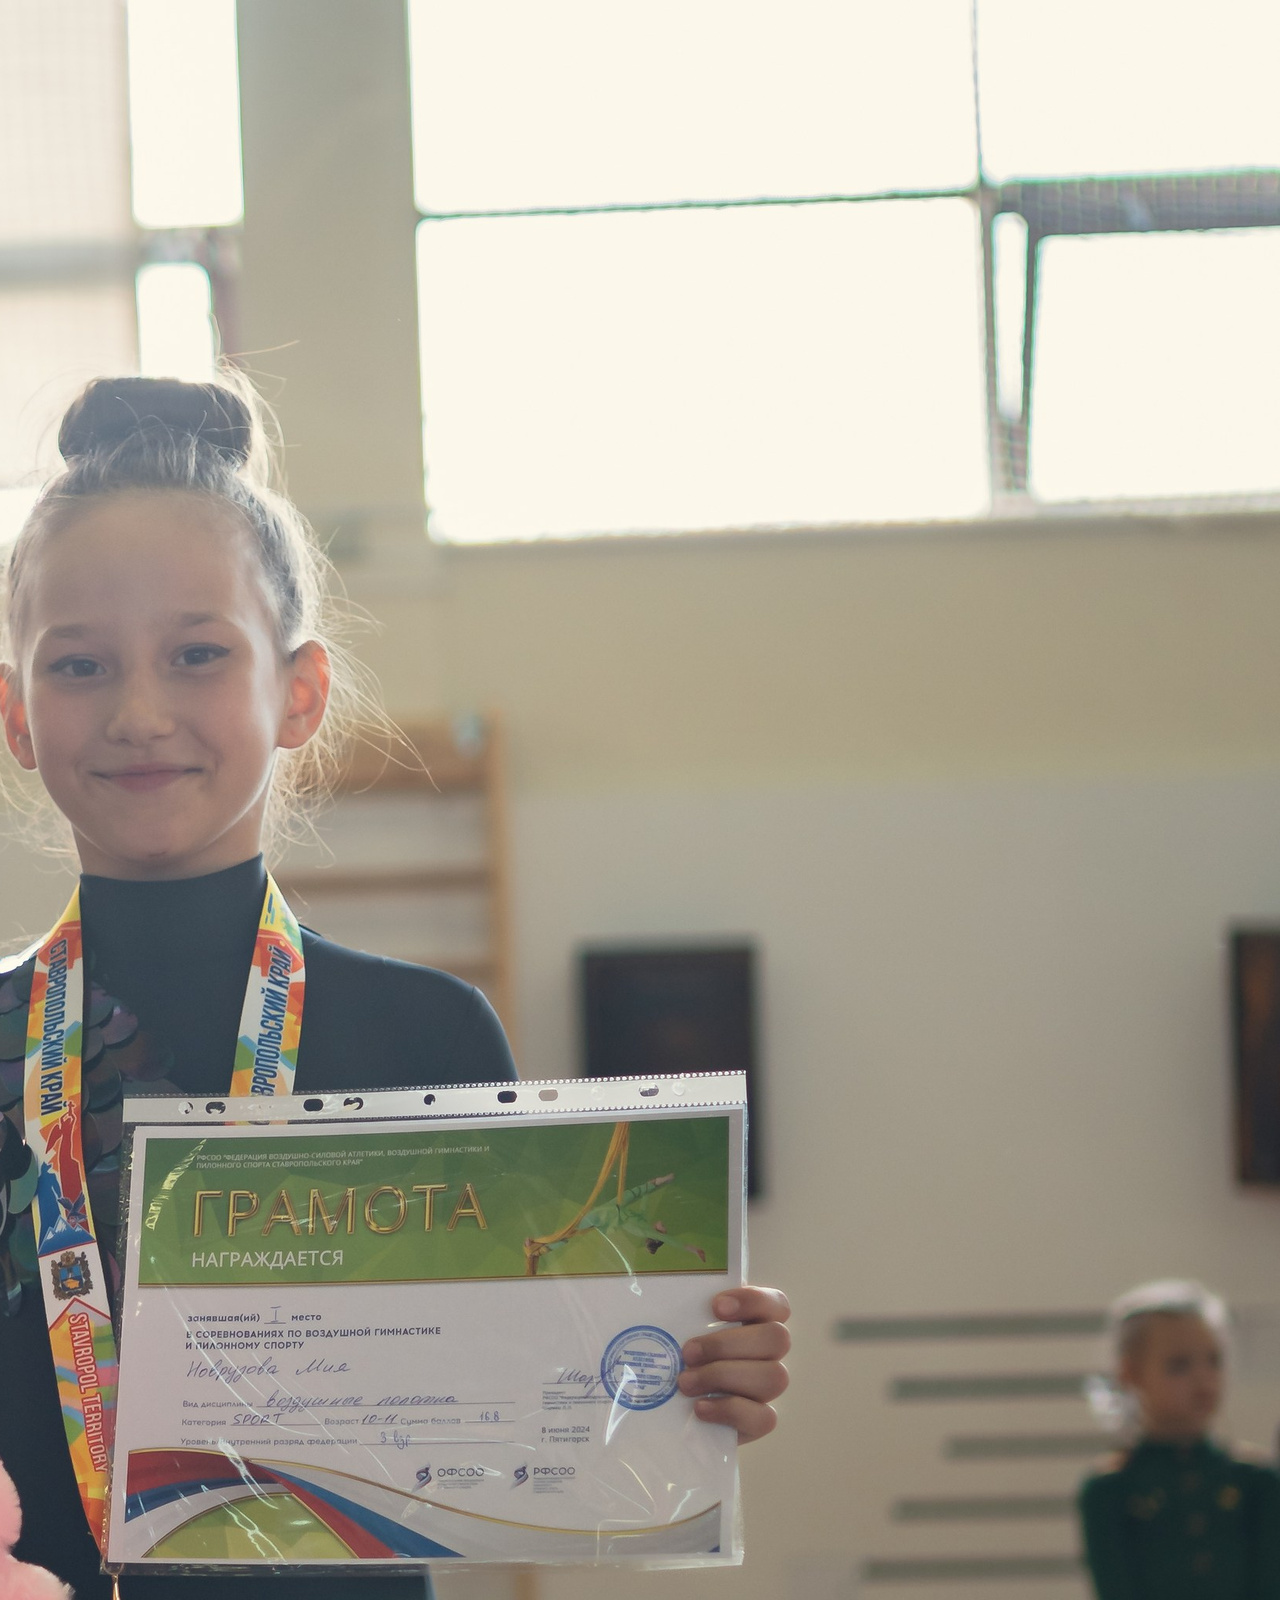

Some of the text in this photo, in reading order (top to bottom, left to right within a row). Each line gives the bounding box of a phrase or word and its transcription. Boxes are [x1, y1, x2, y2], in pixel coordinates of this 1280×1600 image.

[251, 945, 293, 1096] ВРОПОЛЬСКИЙ КРАЙ
[40, 938, 69, 1116] СТАВРОПОЛЬСКИЙ КРАЙ
[196, 1154, 222, 1162] РФСОО
[268, 1150, 347, 1161] ВОЗДУШНО-СИЛОВОЙ
[386, 1147, 433, 1157] ВОЗДУШНОЙ
[434, 1146, 483, 1155] ГИМНАСТИКИ
[196, 1161, 242, 1169] ПИЛОННОГО
[271, 1159, 342, 1168] СТАВРОПОЛЬСКОГО
[193, 1183, 488, 1237] ГРАМОТА
[191, 1250, 344, 1269] НАГРАЖДАЕТСЯ
[187, 1313, 261, 1323] занявшая(ий)
[291, 1313, 322, 1322] место
[195, 1329, 284, 1339] СОРЕВНОВАНИЯХ
[287, 1329, 302, 1338] ПО
[305, 1326, 371, 1339] ВОЗДУШНОЙ
[374, 1326, 442, 1337] ГИМНАСТИКЕ
[185, 1340, 305, 1350] И ПИЛОННОМУ СПОРТУ
[69, 1312, 108, 1473] STAVROPOL TERRITORY
[182, 1400, 254, 1410] Вид дисциплины
[181, 1418, 227, 1428] Категория
[232, 1412, 285, 1425] SPORT
[324, 1417, 360, 1426] Возраст
[400, 1416, 462, 1427] Сумма баллов
[571, 1426, 591, 1434] 2024
[273, 1437, 306, 1447] разряд
[306, 1436, 358, 1447] федерации
[548, 1435, 590, 1444] Пятигорск
[533, 1466, 576, 1476] РФСОО
